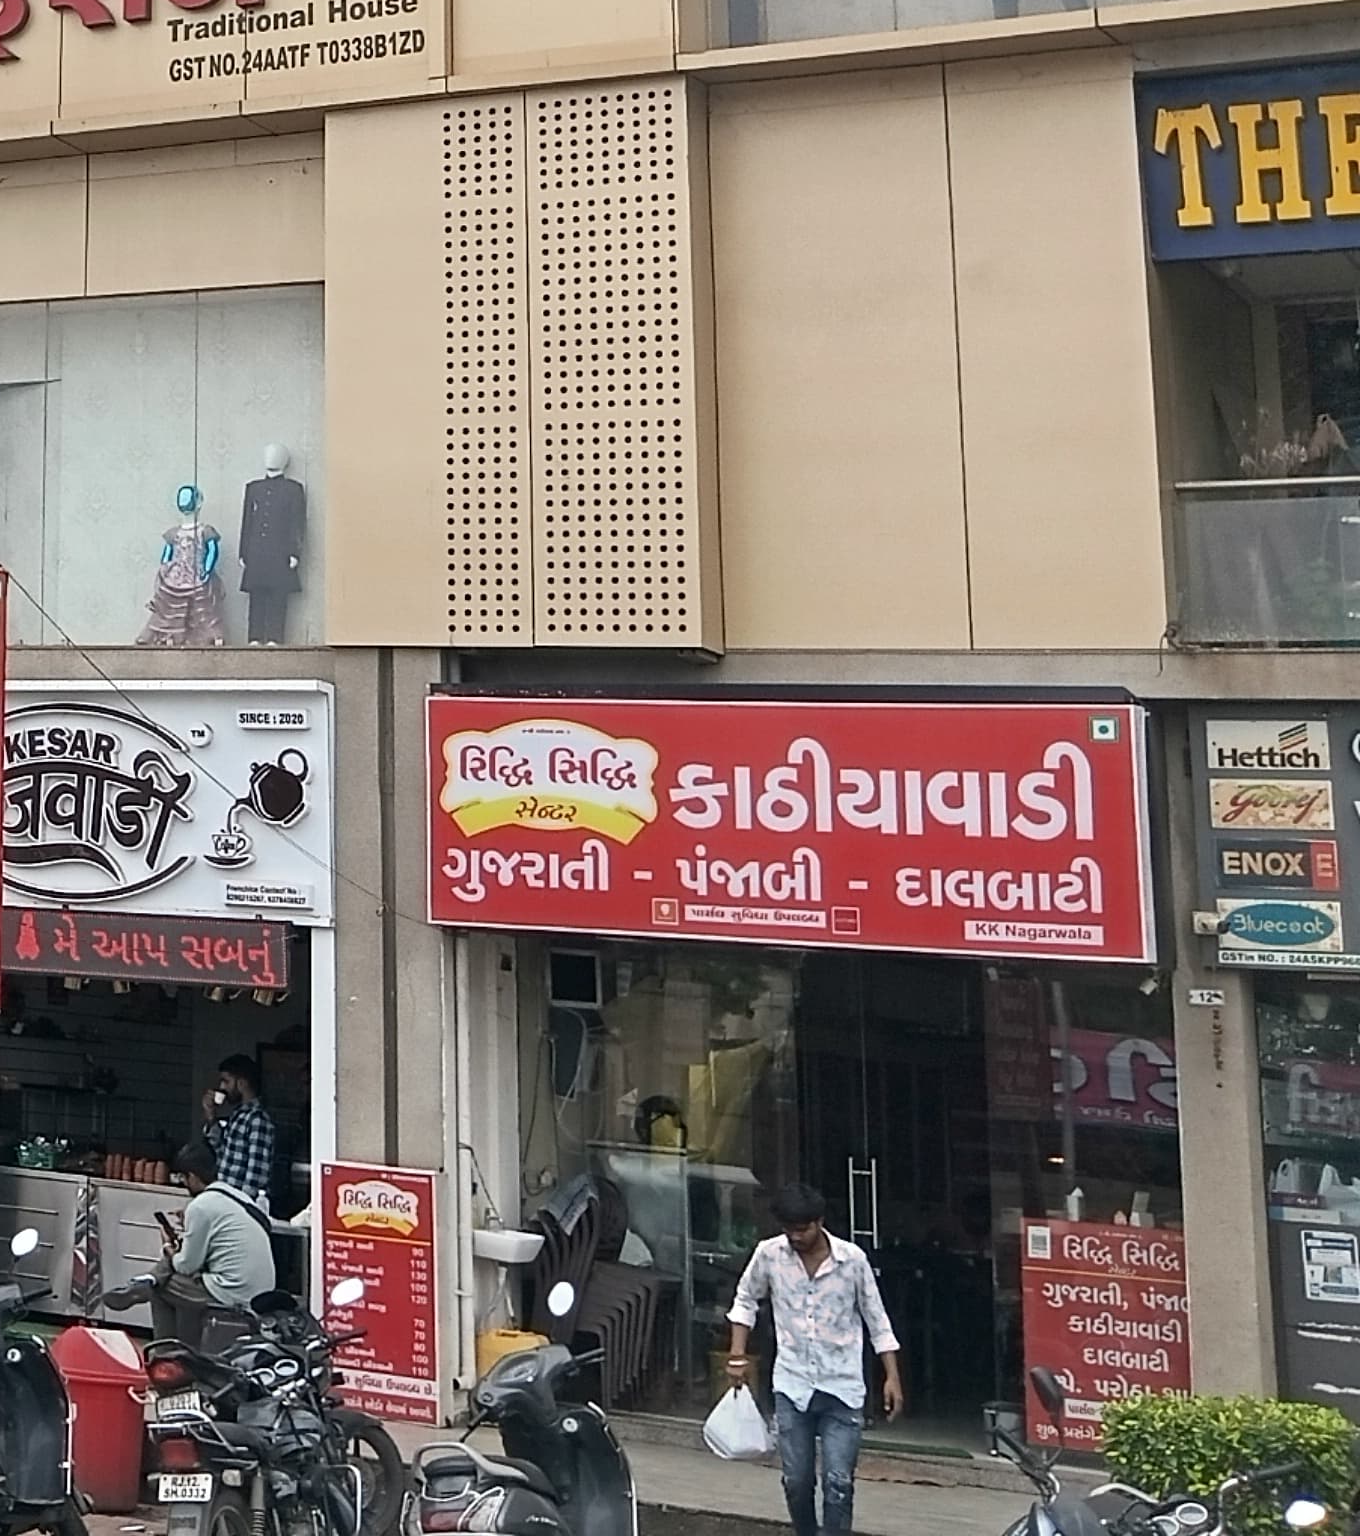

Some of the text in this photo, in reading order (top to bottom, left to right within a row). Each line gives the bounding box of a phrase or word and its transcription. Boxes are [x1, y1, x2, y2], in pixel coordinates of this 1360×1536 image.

[167, 1, 316, 44] Traditional
[4, 728, 117, 766] KESAR
[1217, 747, 1320, 768] Hettich
[668, 737, 1094, 841] કાઠીયાવાડી
[513, 796, 578, 823] સેન્ટર
[441, 838, 1103, 915] ગુજરાતી પંજાબી દાલબાટી
[1222, 851, 1304, 877] ENOX
[975, 923, 1092, 940] KK Nagarwala
[1233, 913, 1324, 935] Bluecoat
[1067, 1313, 1182, 1345] કાઠીયાવાડી
[1082, 1345, 1170, 1375] દાલબાટી
